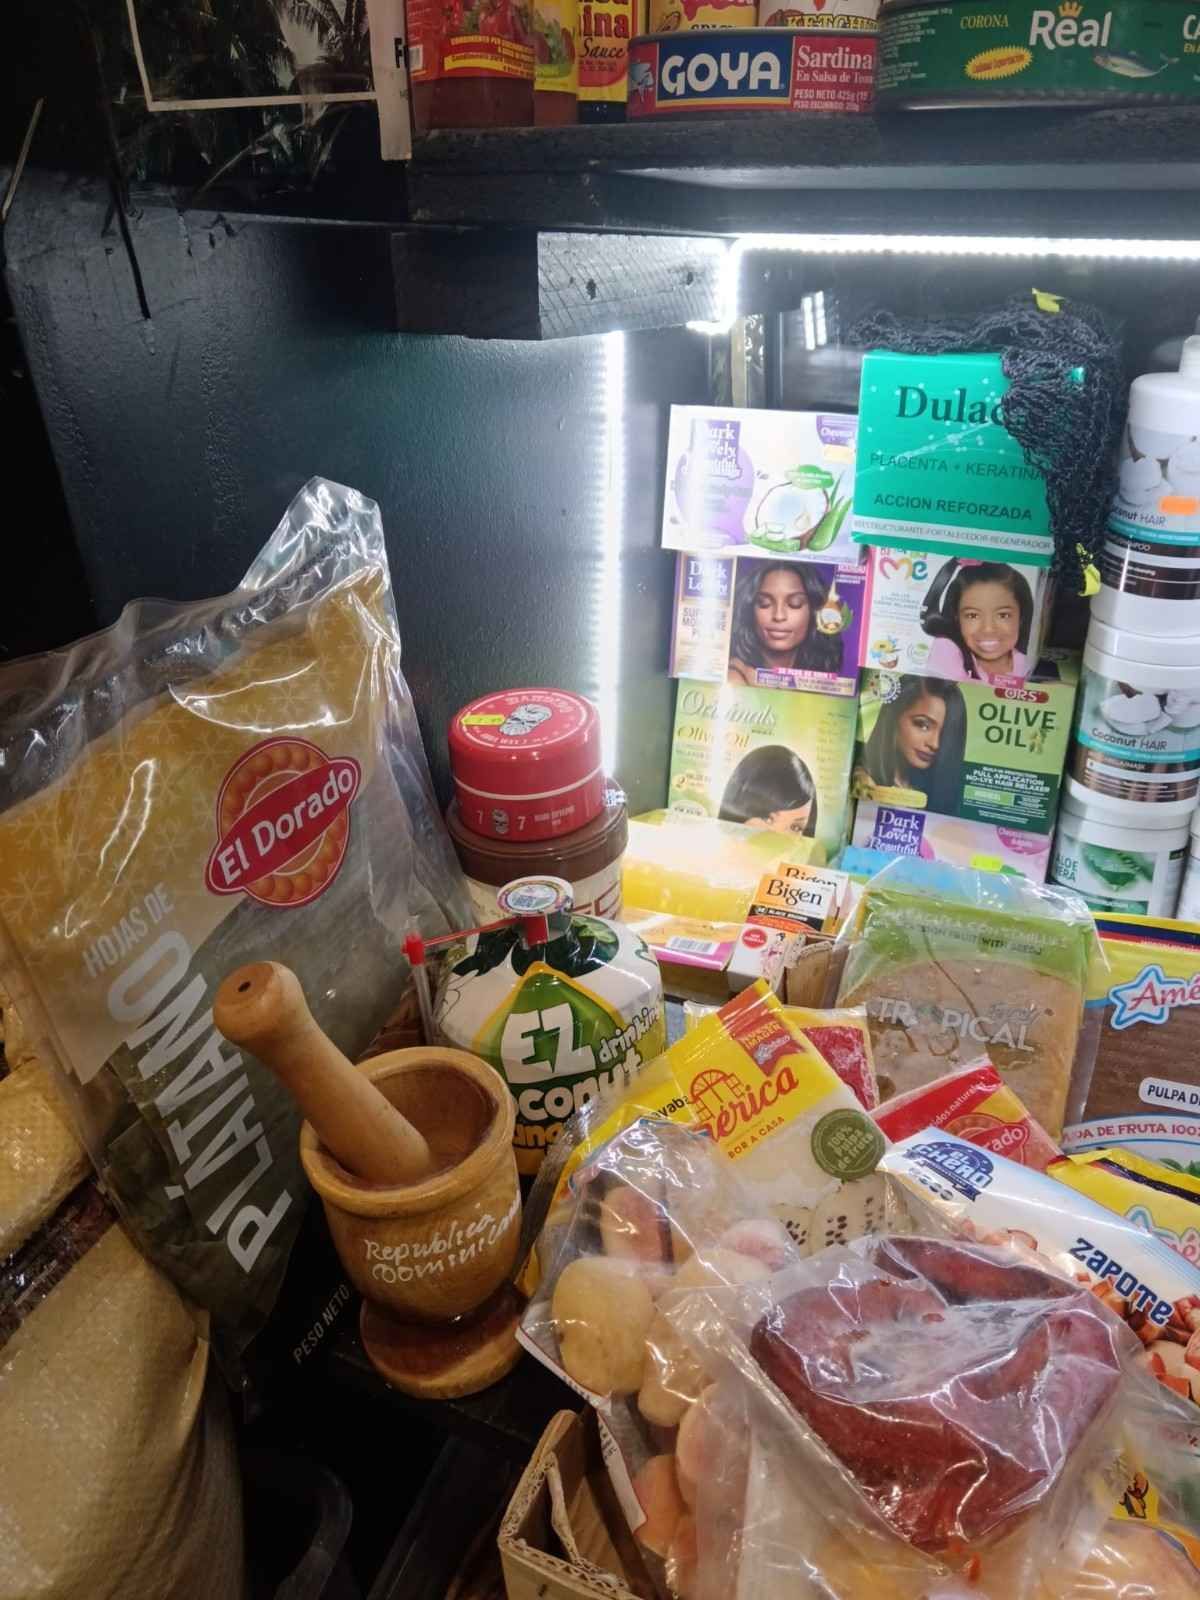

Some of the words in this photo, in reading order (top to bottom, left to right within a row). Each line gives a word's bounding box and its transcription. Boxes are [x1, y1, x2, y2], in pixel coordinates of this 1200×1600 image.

[960, 14, 1009, 29] CORONA
[1028, 10, 1113, 50] Real
[580, 36, 627, 58] Sauce
[797, 44, 873, 70] Sardina
[661, 52, 780, 96] GOYA
[869, 453, 949, 473] PLACENTA
[874, 493, 932, 512] ACCION
[935, 500, 1032, 521] REFORZADA
[978, 702, 1057, 731] OLIVE
[985, 725, 1027, 748] OIL
[1091, 727, 1137, 748] Coconut
[1140, 740, 1168, 751] HAIR
[217, 837, 250, 886] El
[251, 768, 353, 857] Dorado
[880, 809, 920, 831] Dark
[877, 825, 921, 845] Lovely
[766, 878, 823, 906] Bigen
[81, 907, 150, 978] HOJAS
[143, 883, 176, 925] DE
[501, 1003, 597, 1084] EZ
[1147, 1084, 1187, 1103] PULPA
[1097, 1125, 1116, 1138] DE
[1117, 1123, 1167, 1136] FRUTA
[292, 1320, 325, 1365] PESO
[321, 1283, 351, 1328] NETO
